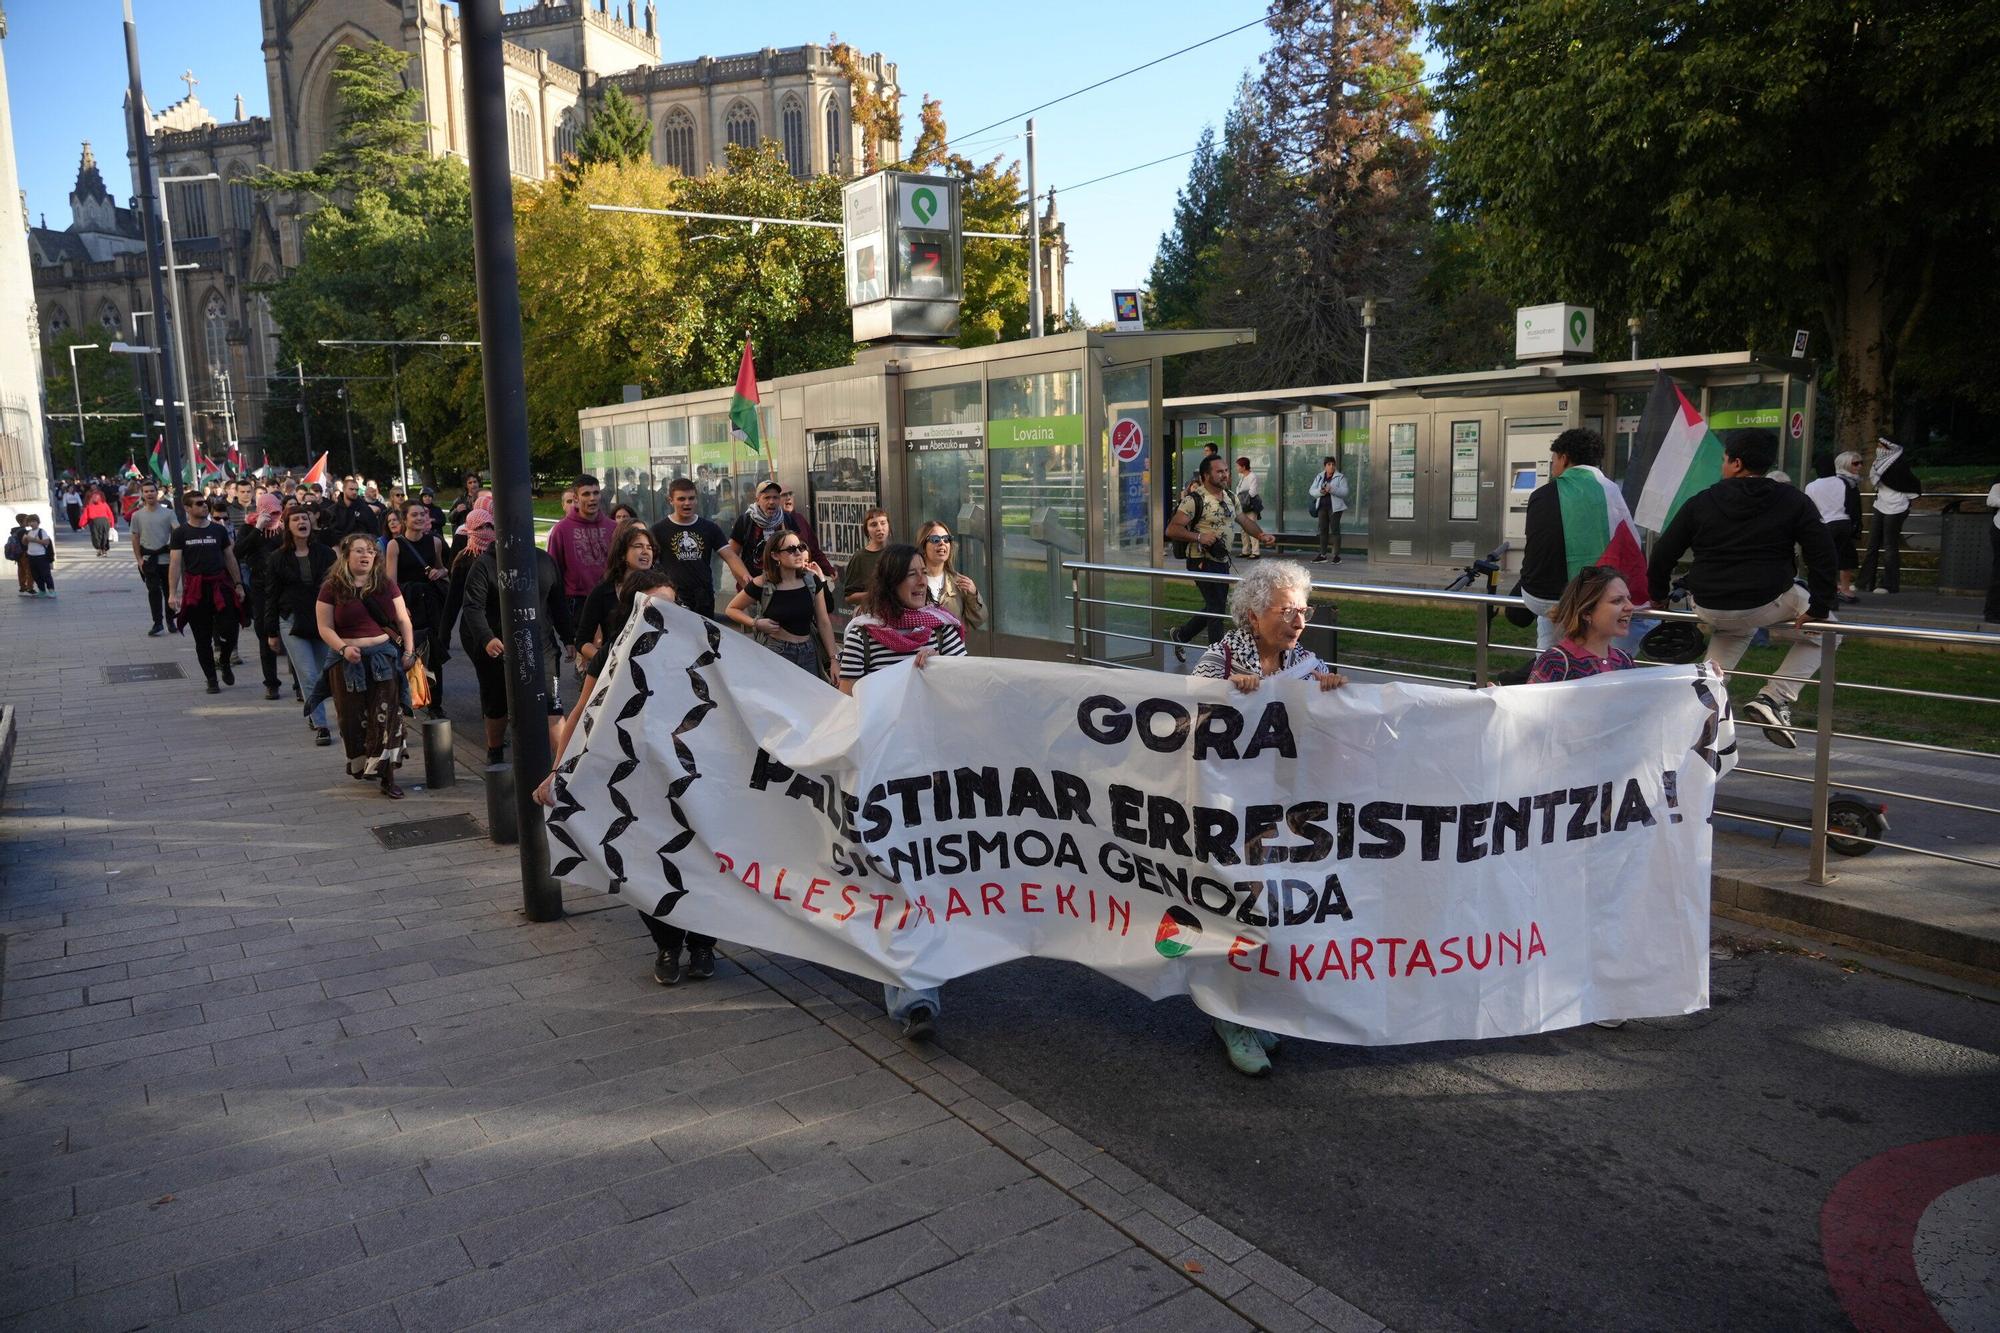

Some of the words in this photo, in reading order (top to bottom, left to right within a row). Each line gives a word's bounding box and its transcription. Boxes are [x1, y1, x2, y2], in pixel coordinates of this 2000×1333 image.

[1736, 414, 1779, 425] Lovaina
[1013, 425, 1055, 441] Lovaina
[929, 439, 958, 450] Abetxuko
[818, 503, 830, 523] UN
[573, 527, 607, 539] SURF
[1077, 694, 1297, 761] GORA
[1098, 841, 1353, 928] GENOZIDA
[1228, 921, 1547, 982] ELKARTASUNA
